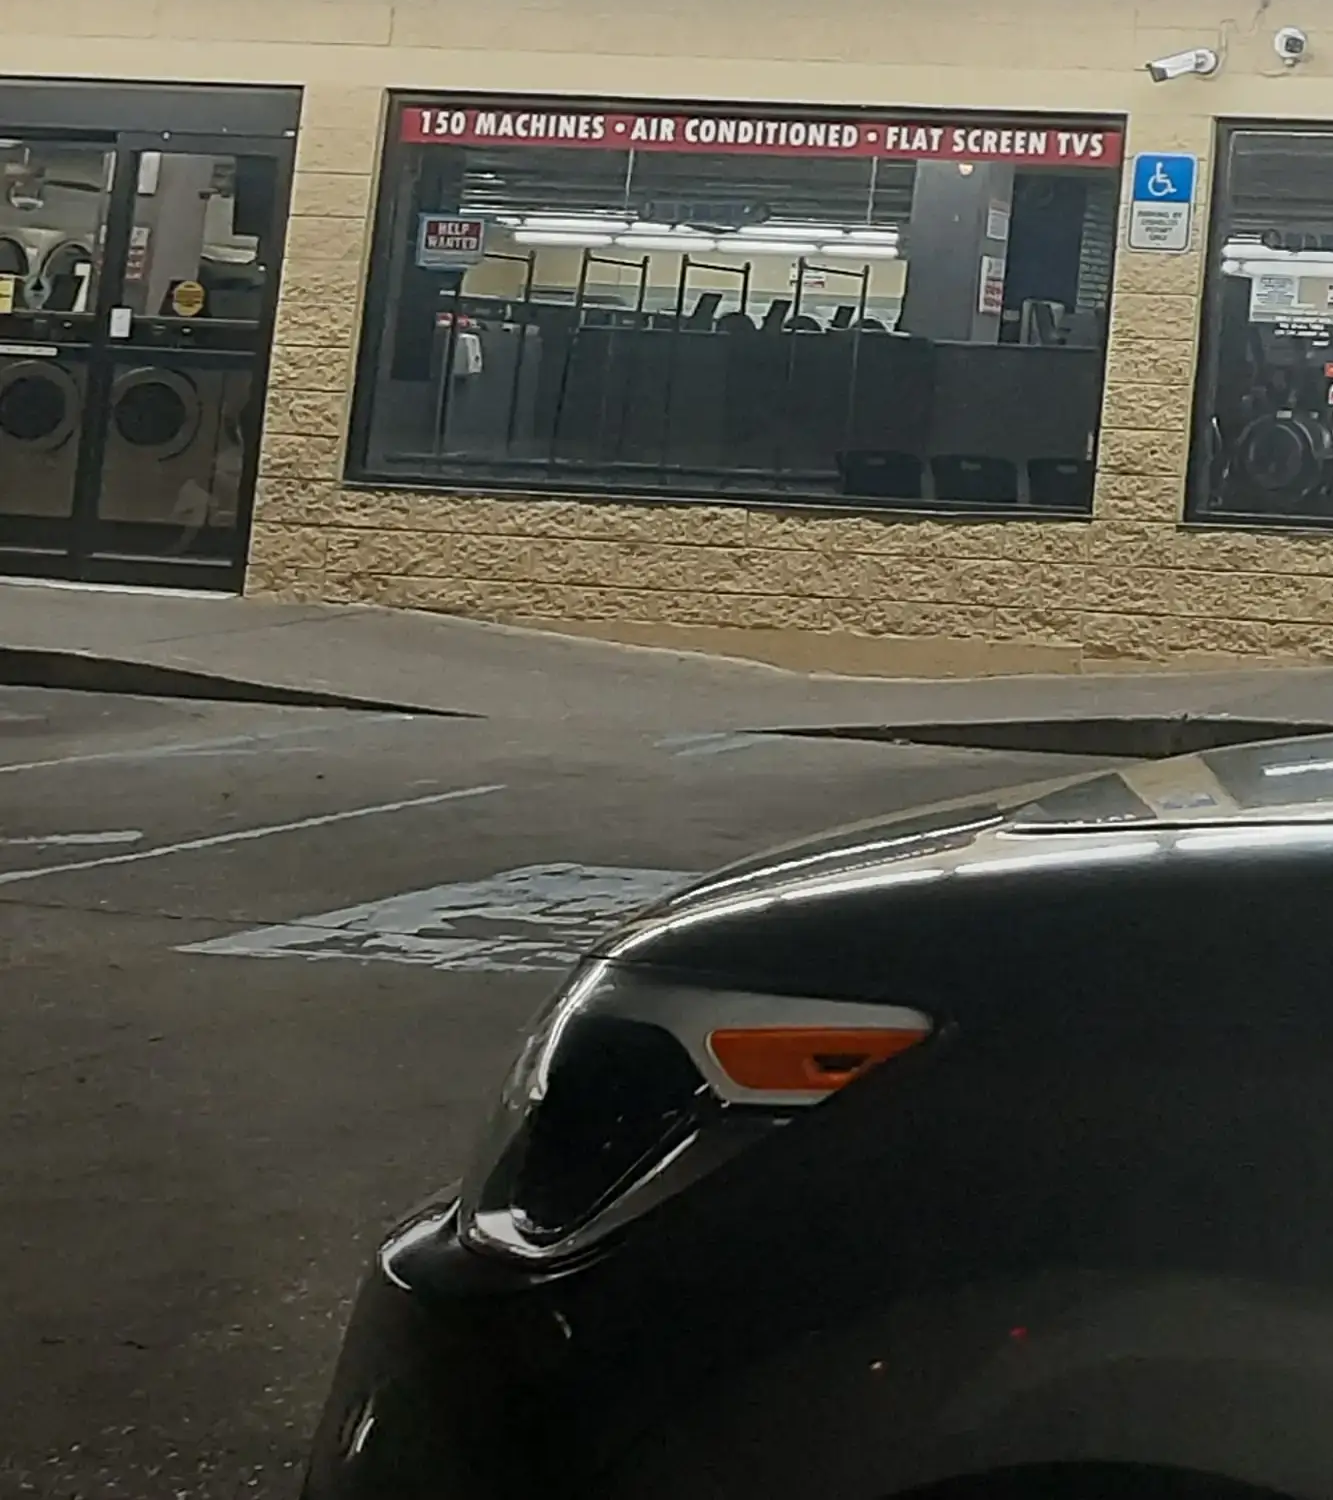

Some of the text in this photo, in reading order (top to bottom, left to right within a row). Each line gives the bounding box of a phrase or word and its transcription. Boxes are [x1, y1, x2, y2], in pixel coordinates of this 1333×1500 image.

[420, 110, 1104, 158] 150 MACHINES AIR CONDITIONED FLAT SCREEN TVS
[437, 222, 471, 236] HELP
[426, 235, 479, 250] WANTED
